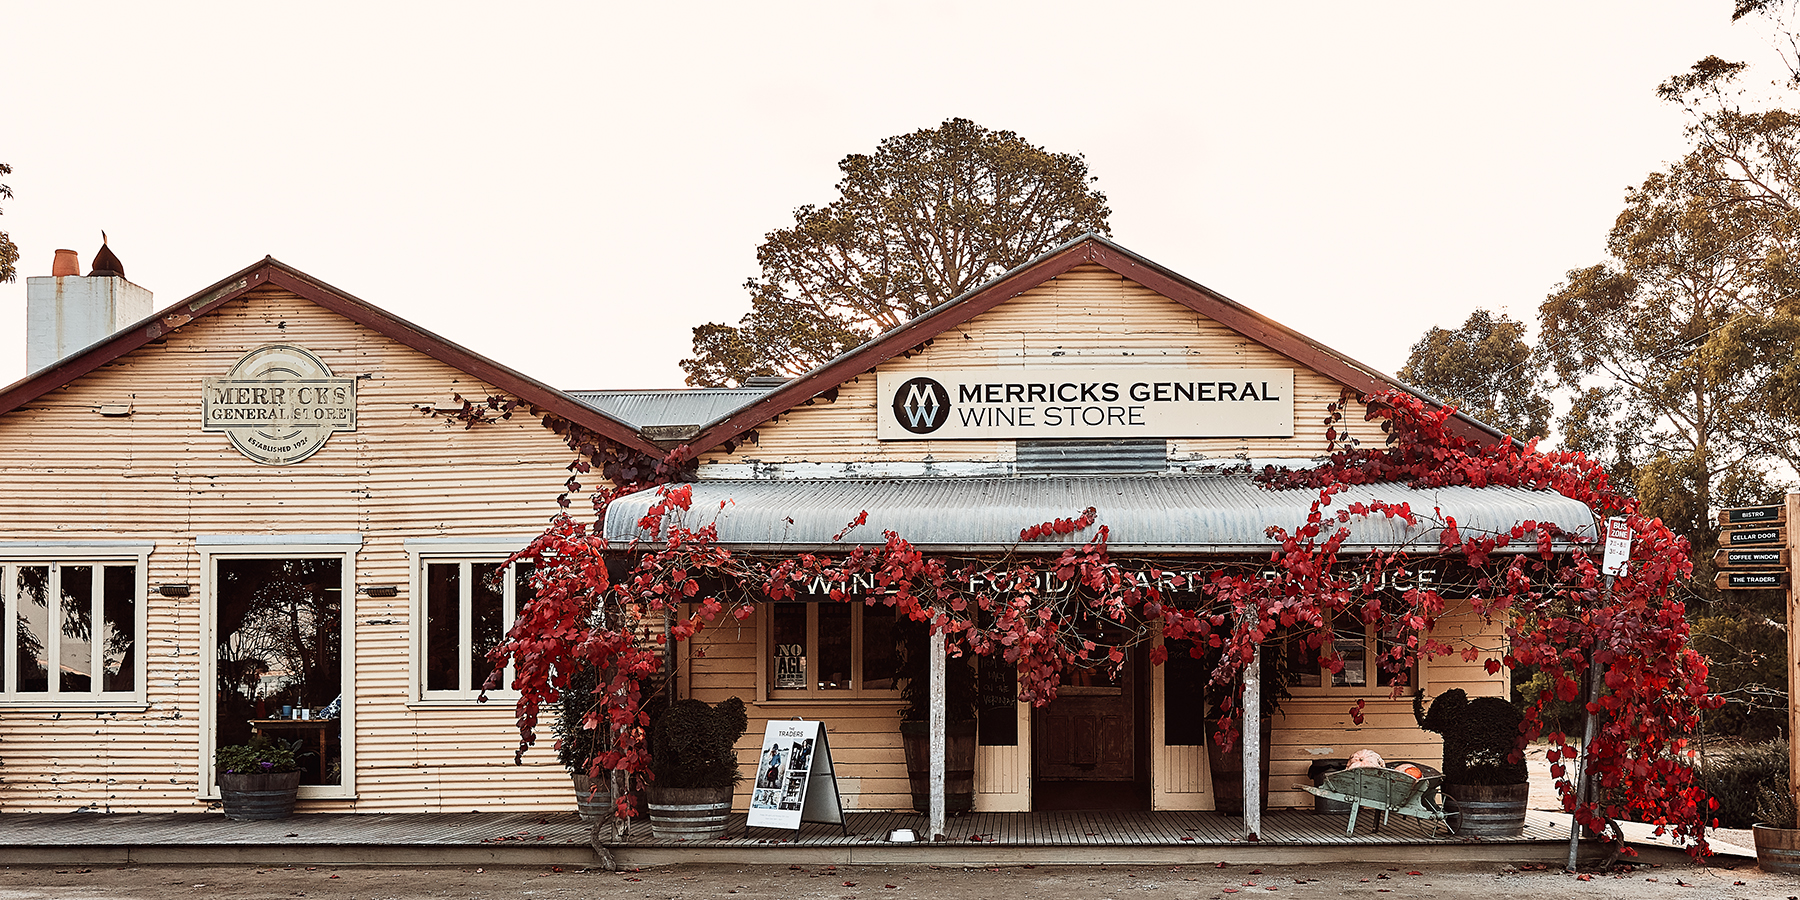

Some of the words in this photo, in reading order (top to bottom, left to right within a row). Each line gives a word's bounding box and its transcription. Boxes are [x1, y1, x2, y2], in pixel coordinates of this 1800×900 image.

[958, 382, 1120, 403] MERRICKS
[1129, 381, 1280, 402] GENERAL
[211, 408, 288, 420] GENERAL
[293, 408, 347, 420] STORE
[957, 406, 1036, 427] WINE
[1043, 405, 1146, 427] STORE
[247, 437, 291, 453] ESTABLISHED
[1612, 521, 1628, 531] BUS
[1610, 530, 1629, 539] ZONE
[969, 571, 1068, 593] FOOD
[1128, 571, 1201, 593] ART
[778, 643, 803, 656] NO
[778, 730, 804, 738] TRADERS
